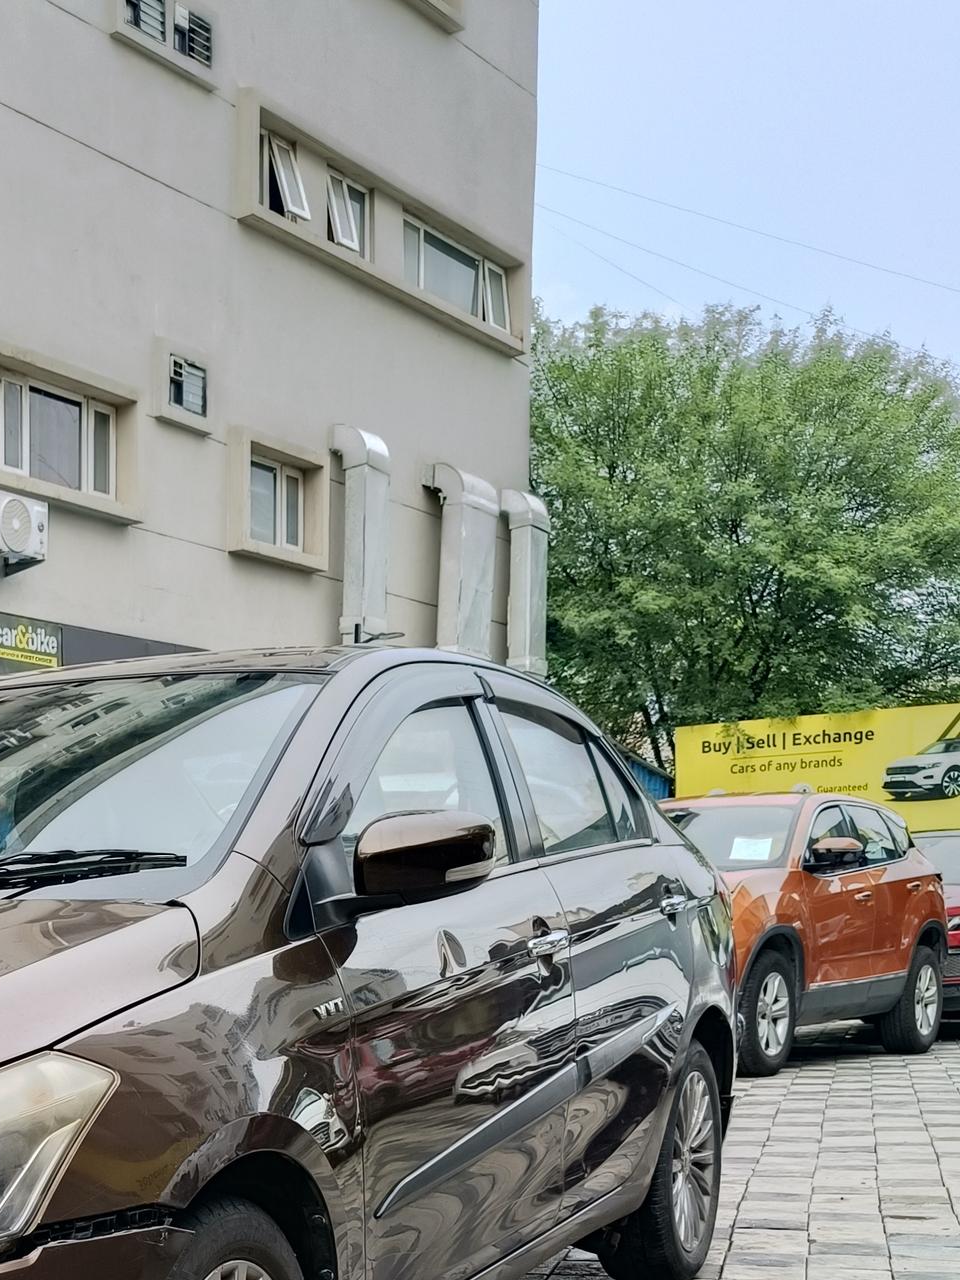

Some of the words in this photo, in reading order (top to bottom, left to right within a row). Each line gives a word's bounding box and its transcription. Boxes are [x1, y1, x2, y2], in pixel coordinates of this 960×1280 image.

[701, 739, 732, 756] Buy
[746, 733, 777, 750] Sell
[792, 727, 875, 747] Exchange
[730, 763, 757, 775] Cars
[759, 760, 772, 772] of
[775, 761, 796, 774] any
[800, 756, 843, 770] brands
[816, 783, 868, 793] Guaranteed
